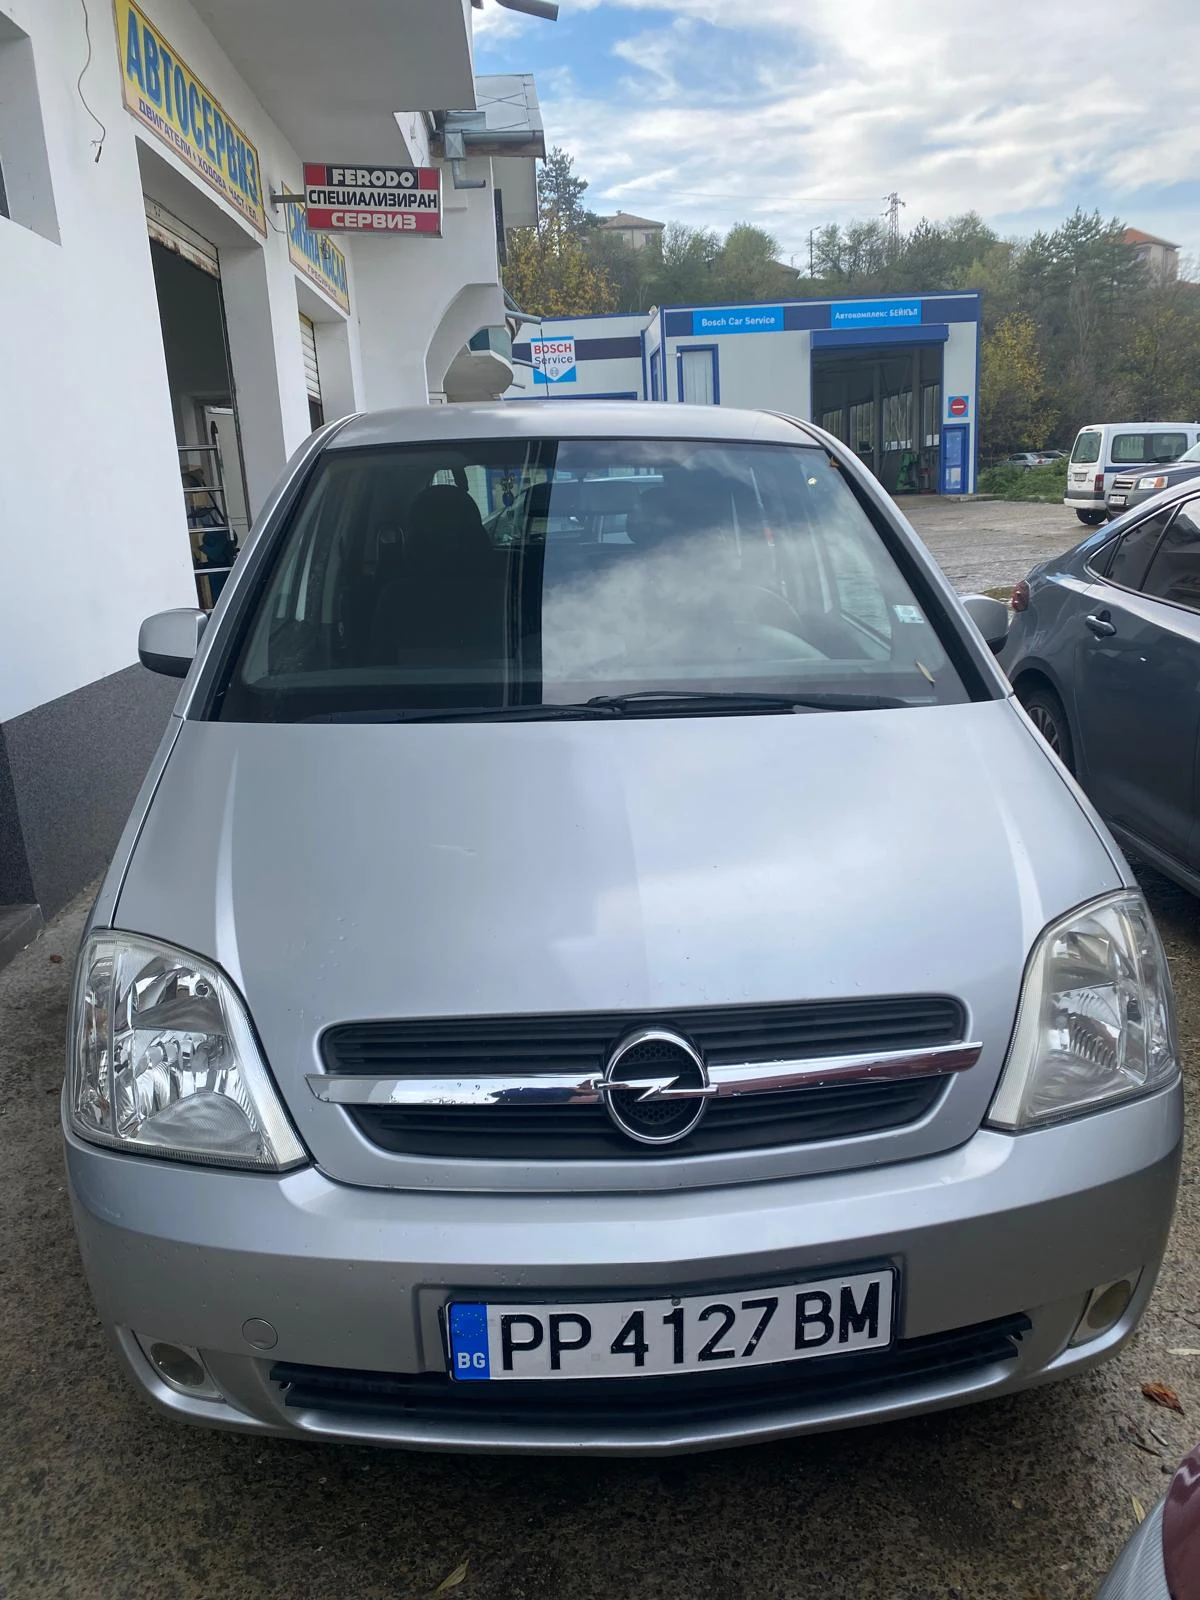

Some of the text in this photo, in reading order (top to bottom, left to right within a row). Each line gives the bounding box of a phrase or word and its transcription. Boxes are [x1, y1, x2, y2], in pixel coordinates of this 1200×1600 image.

[127, 8, 258, 207] АВТОСЕРВИЗ
[139, 97, 192, 158] ДВИГАТЕЛИ
[199, 153, 228, 191] ХОДОВА
[332, 169, 414, 187] FERODO
[308, 190, 437, 208] СПЕЦИАЛИЗИРАН
[331, 212, 417, 229] СЕРВИЗ
[702, 316, 776, 327] Bosch Car Service
[835, 310, 888, 320] Автокомплекс
[534, 343, 572, 354] BOSCH
[534, 355, 573, 365] Service
[610, 1296, 779, 1368] 4127
[457, 1352, 486, 1369] BG
